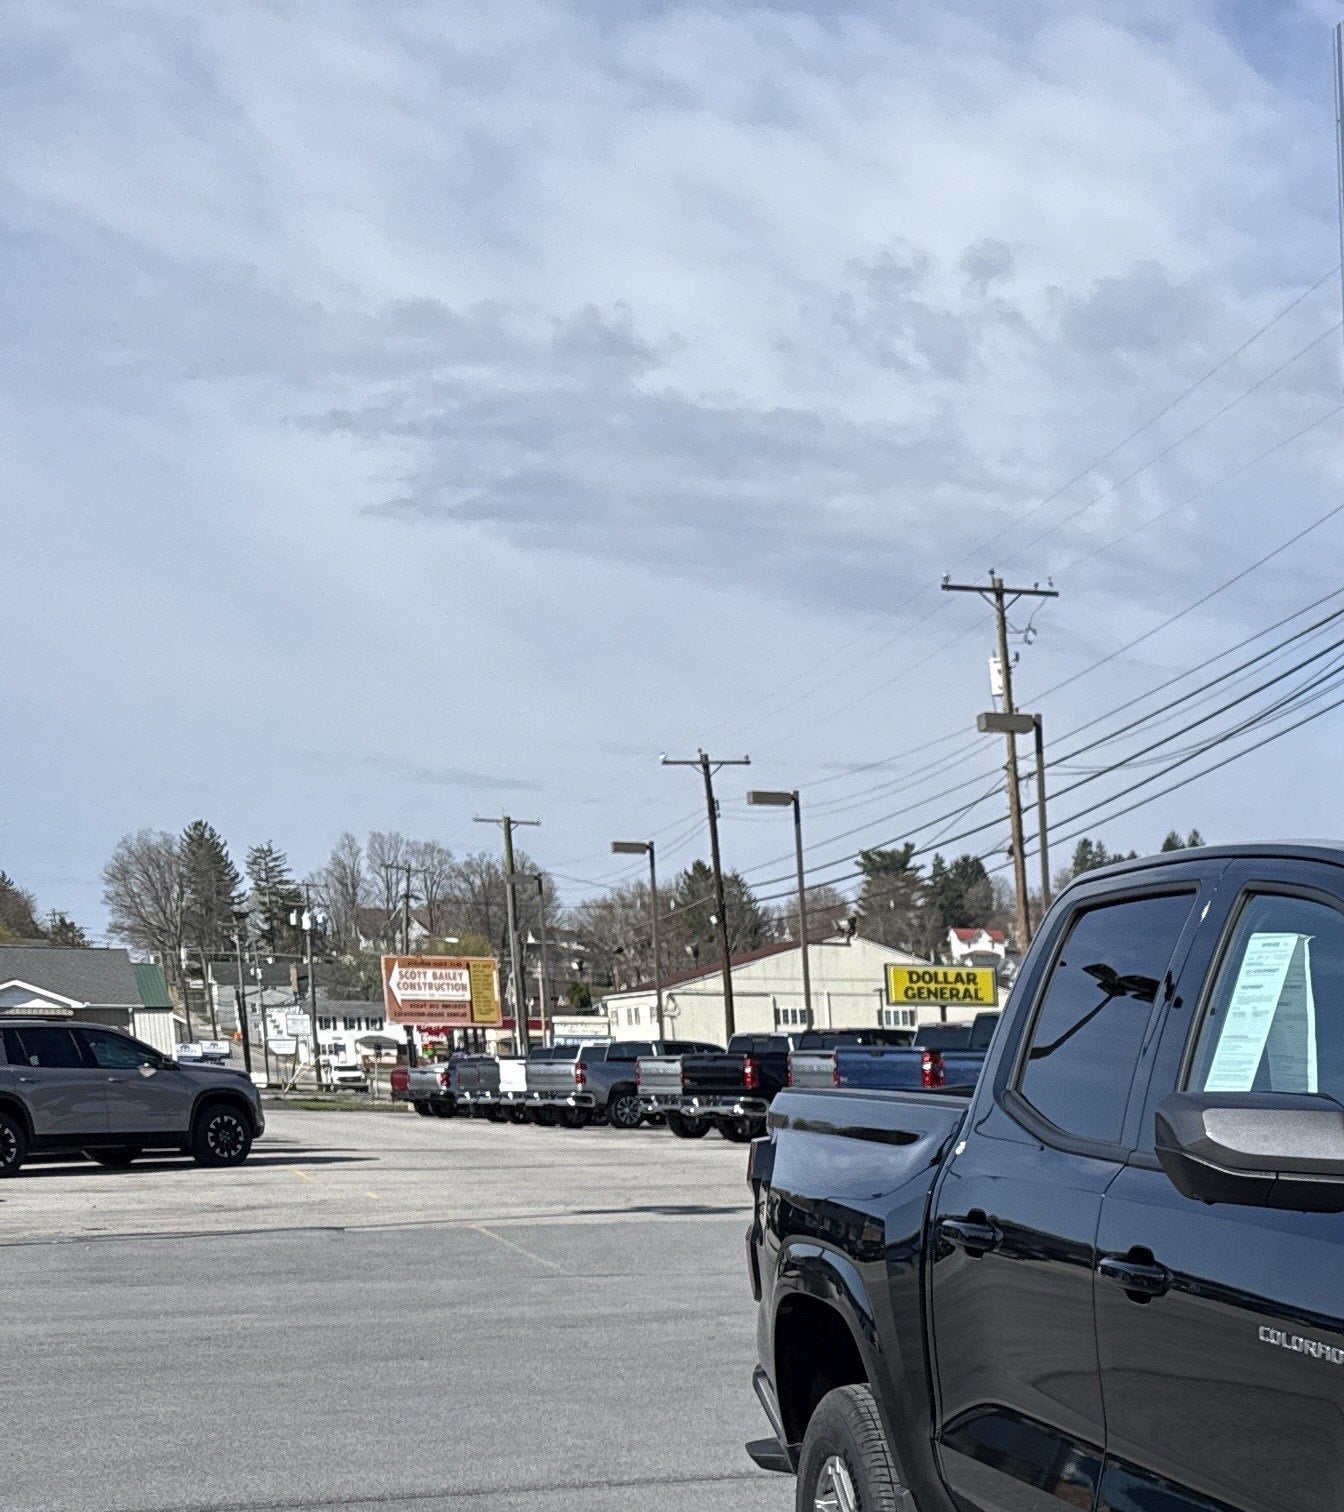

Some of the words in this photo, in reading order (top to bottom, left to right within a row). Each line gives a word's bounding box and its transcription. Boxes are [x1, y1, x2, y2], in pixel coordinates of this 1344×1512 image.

[398, 969, 427, 981] SCOTT
[432, 969, 464, 981] BAILEY
[907, 969, 979, 986] DOLLAR
[396, 981, 468, 993] CONSTRUCTION
[903, 985, 985, 1002] GENERAL
